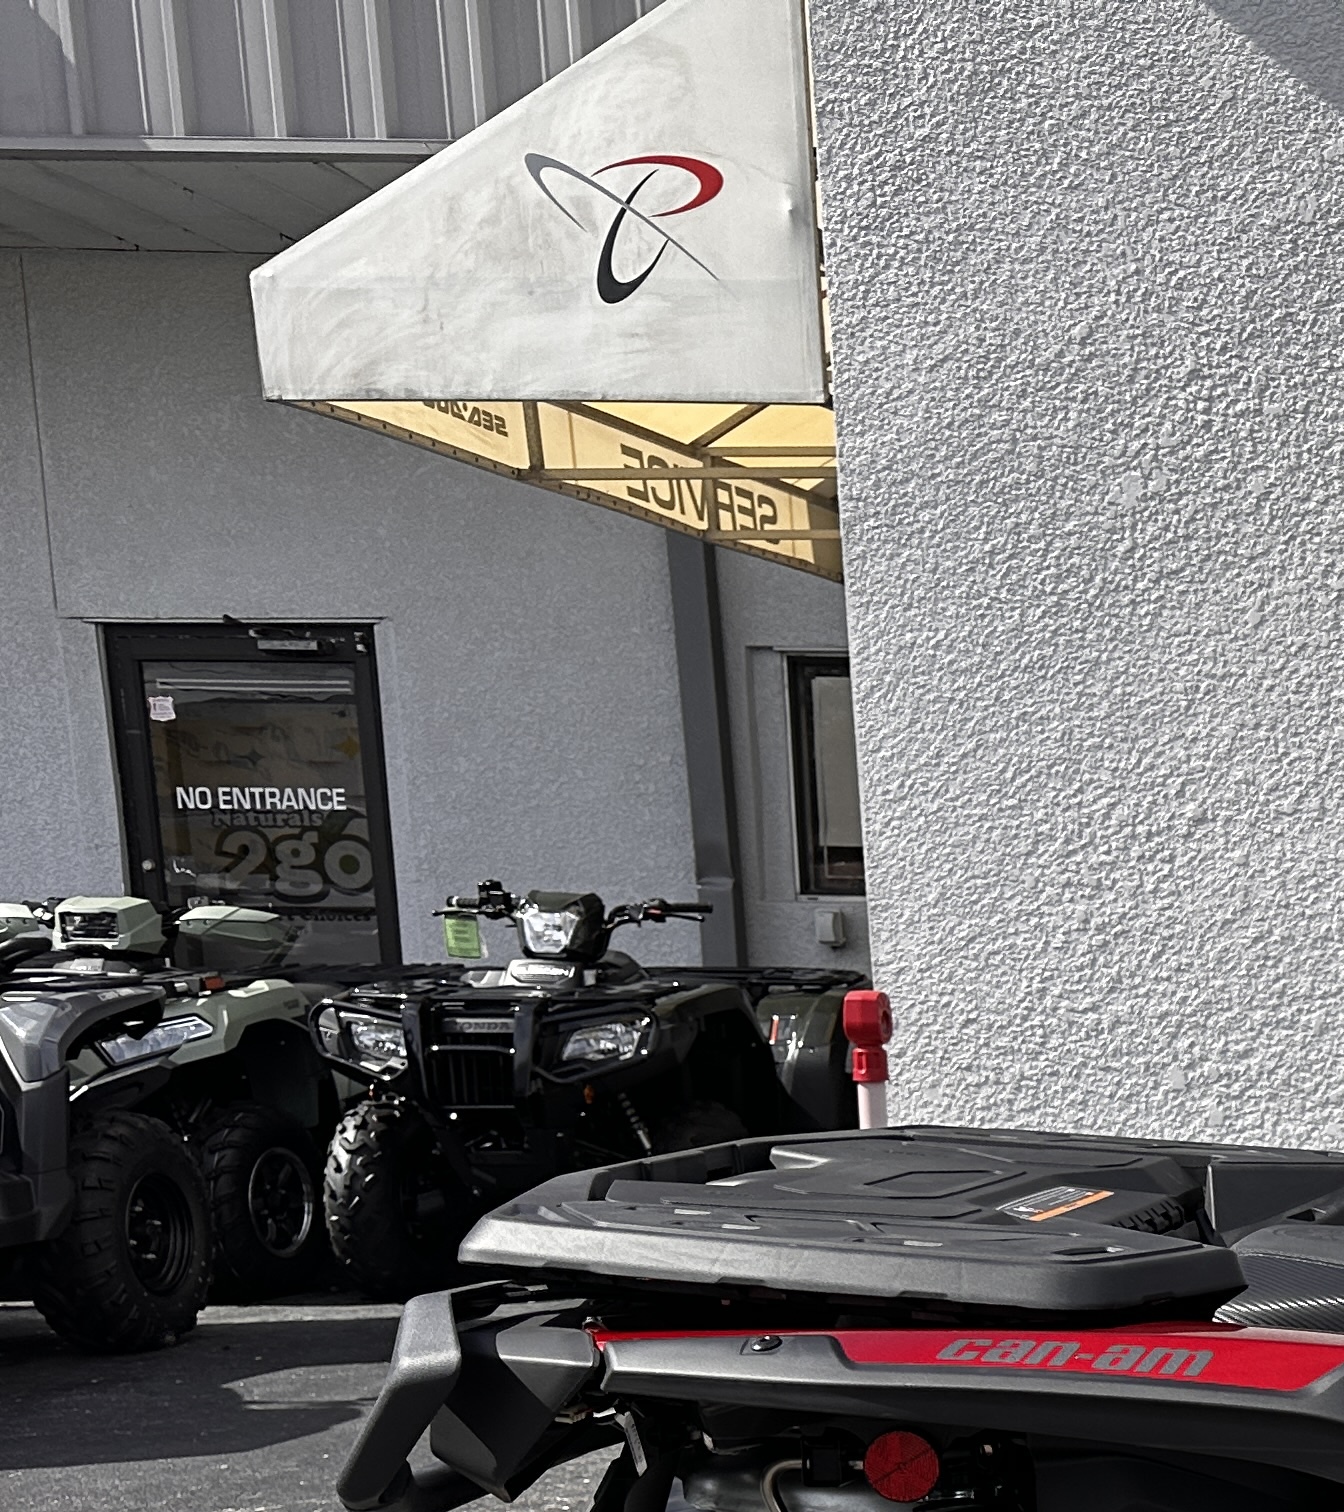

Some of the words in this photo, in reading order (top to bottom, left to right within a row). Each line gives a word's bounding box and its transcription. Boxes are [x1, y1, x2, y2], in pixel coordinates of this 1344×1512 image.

[175, 786, 212, 810] NO
[217, 786, 347, 811] ENTRANCE
[935, 1338, 1214, 1376] can-am
